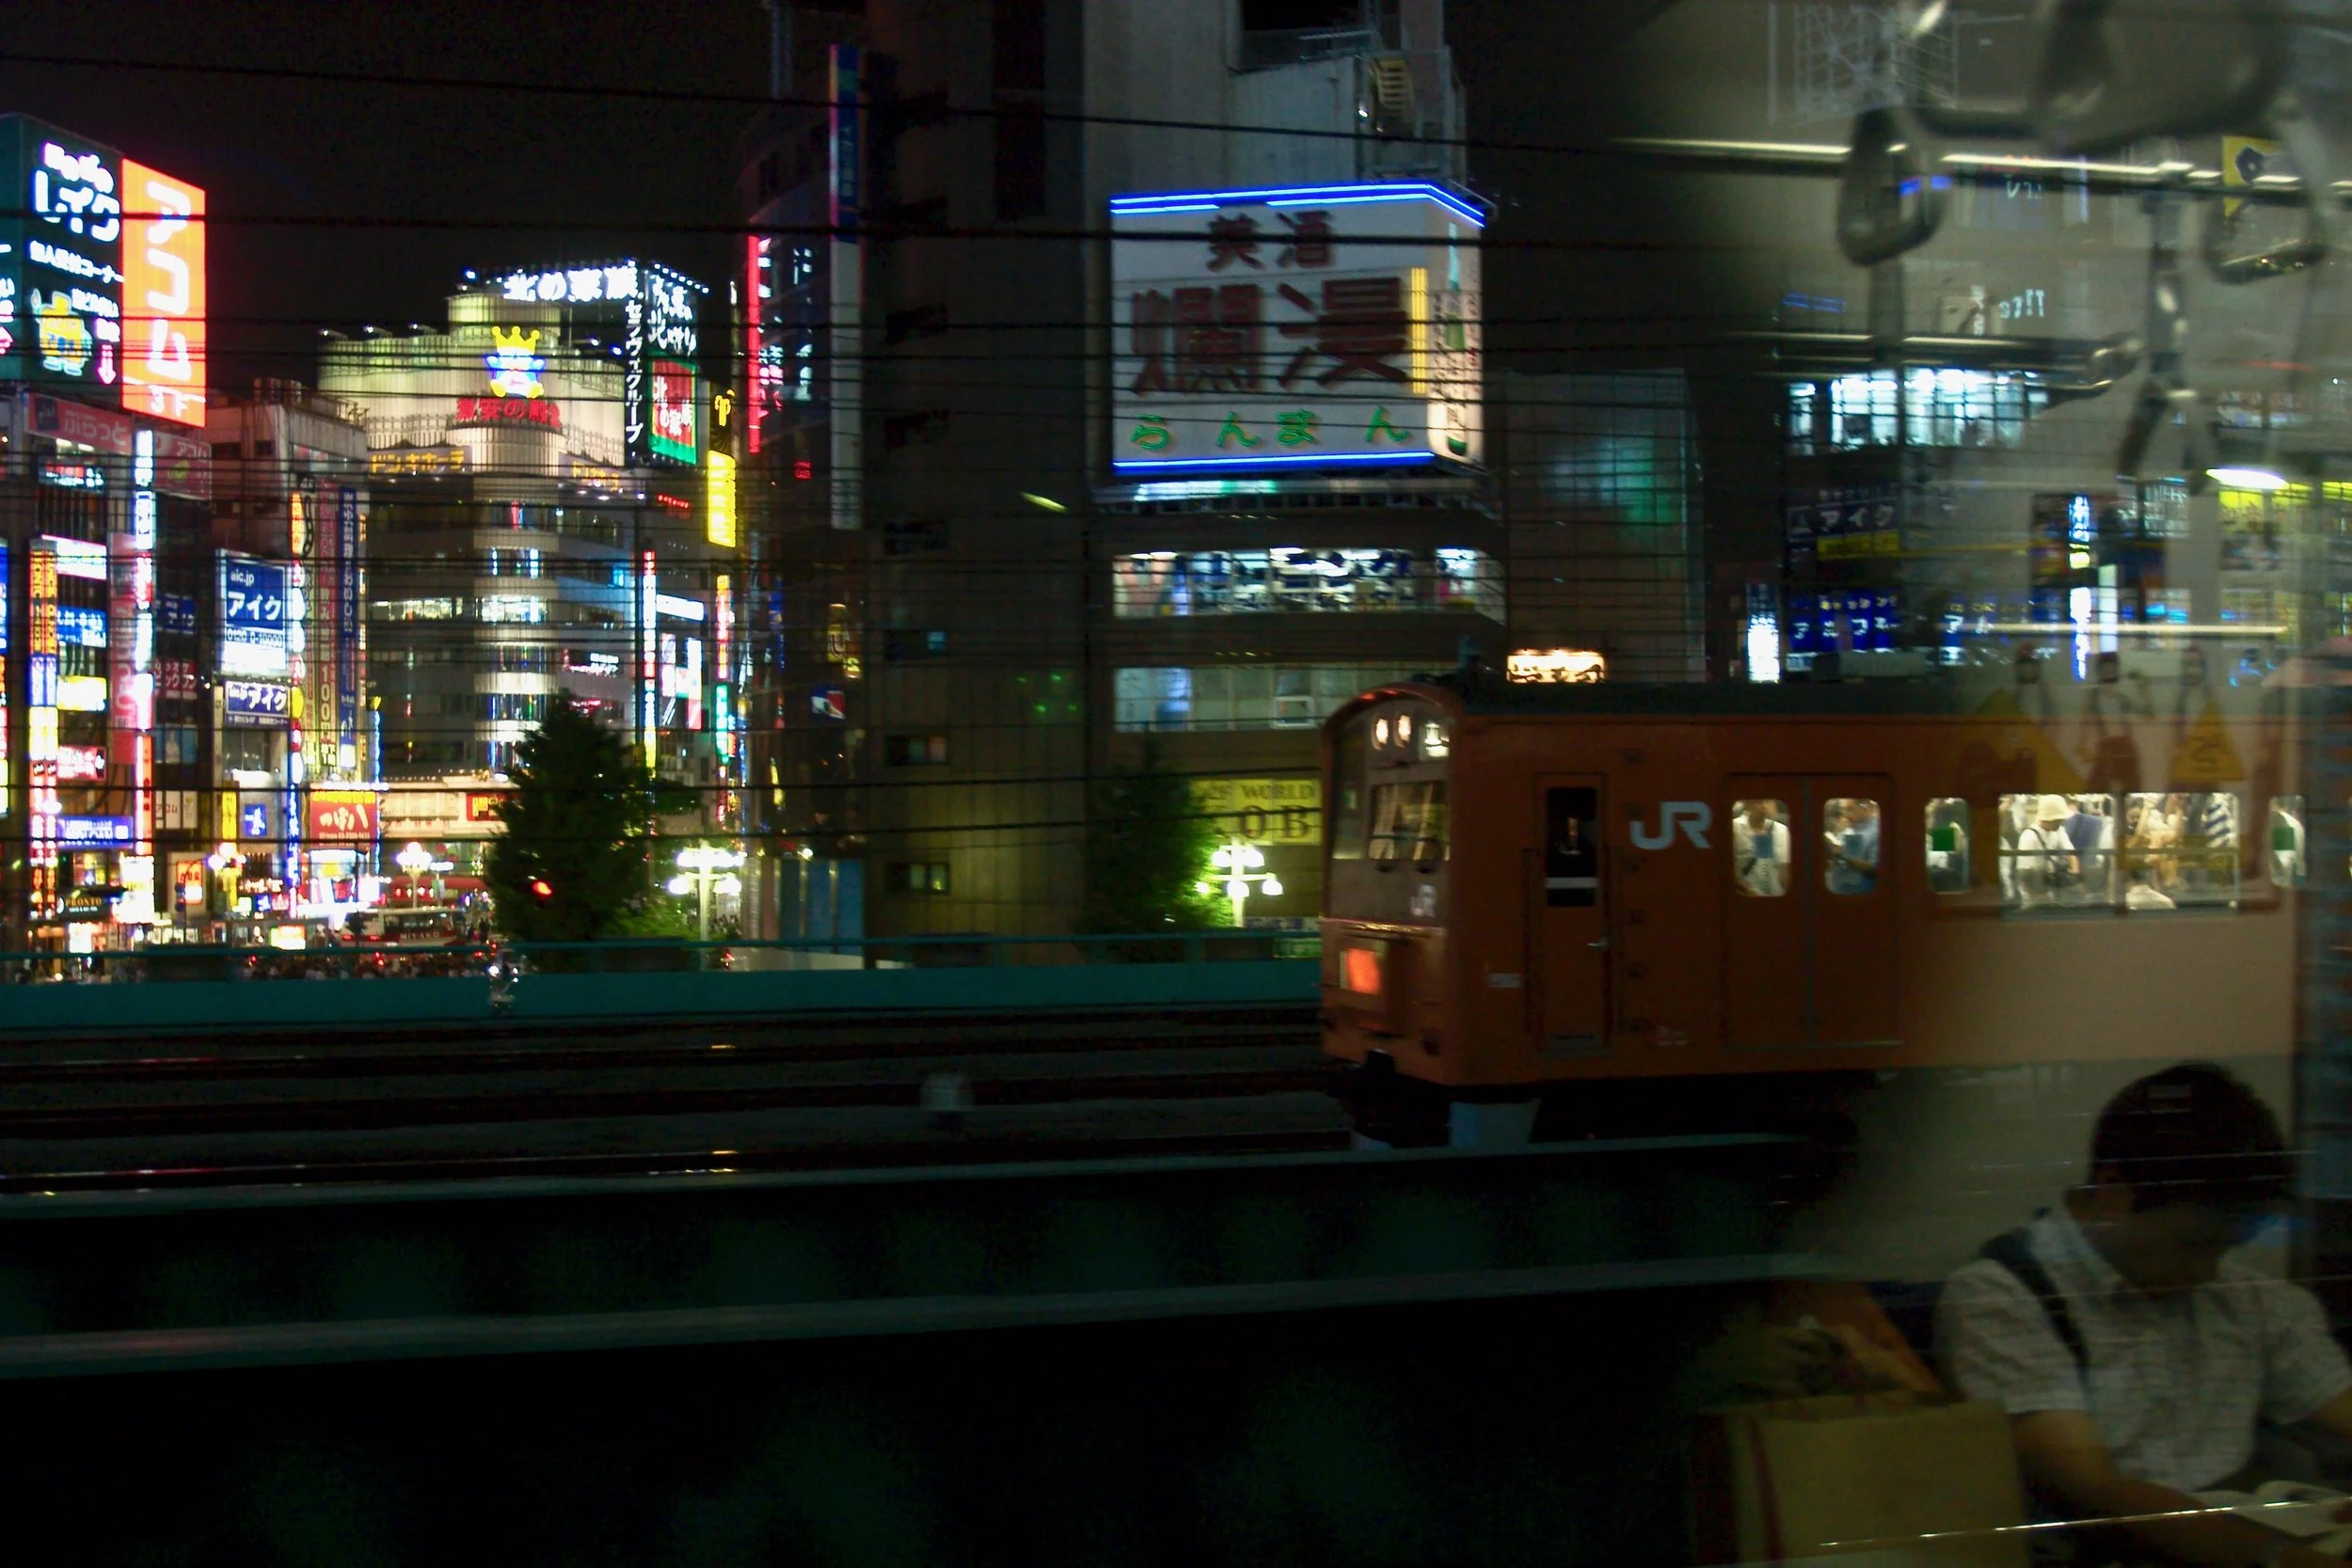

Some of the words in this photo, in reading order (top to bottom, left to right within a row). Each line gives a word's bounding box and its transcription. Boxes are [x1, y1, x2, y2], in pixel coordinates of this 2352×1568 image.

[1132, 405, 1409, 451] らんまん
[227, 590, 282, 621] アイク
[248, 681, 287, 711] アイク
[1630, 800, 1713, 849] JR
[65, 896, 103, 908] PRONTO
